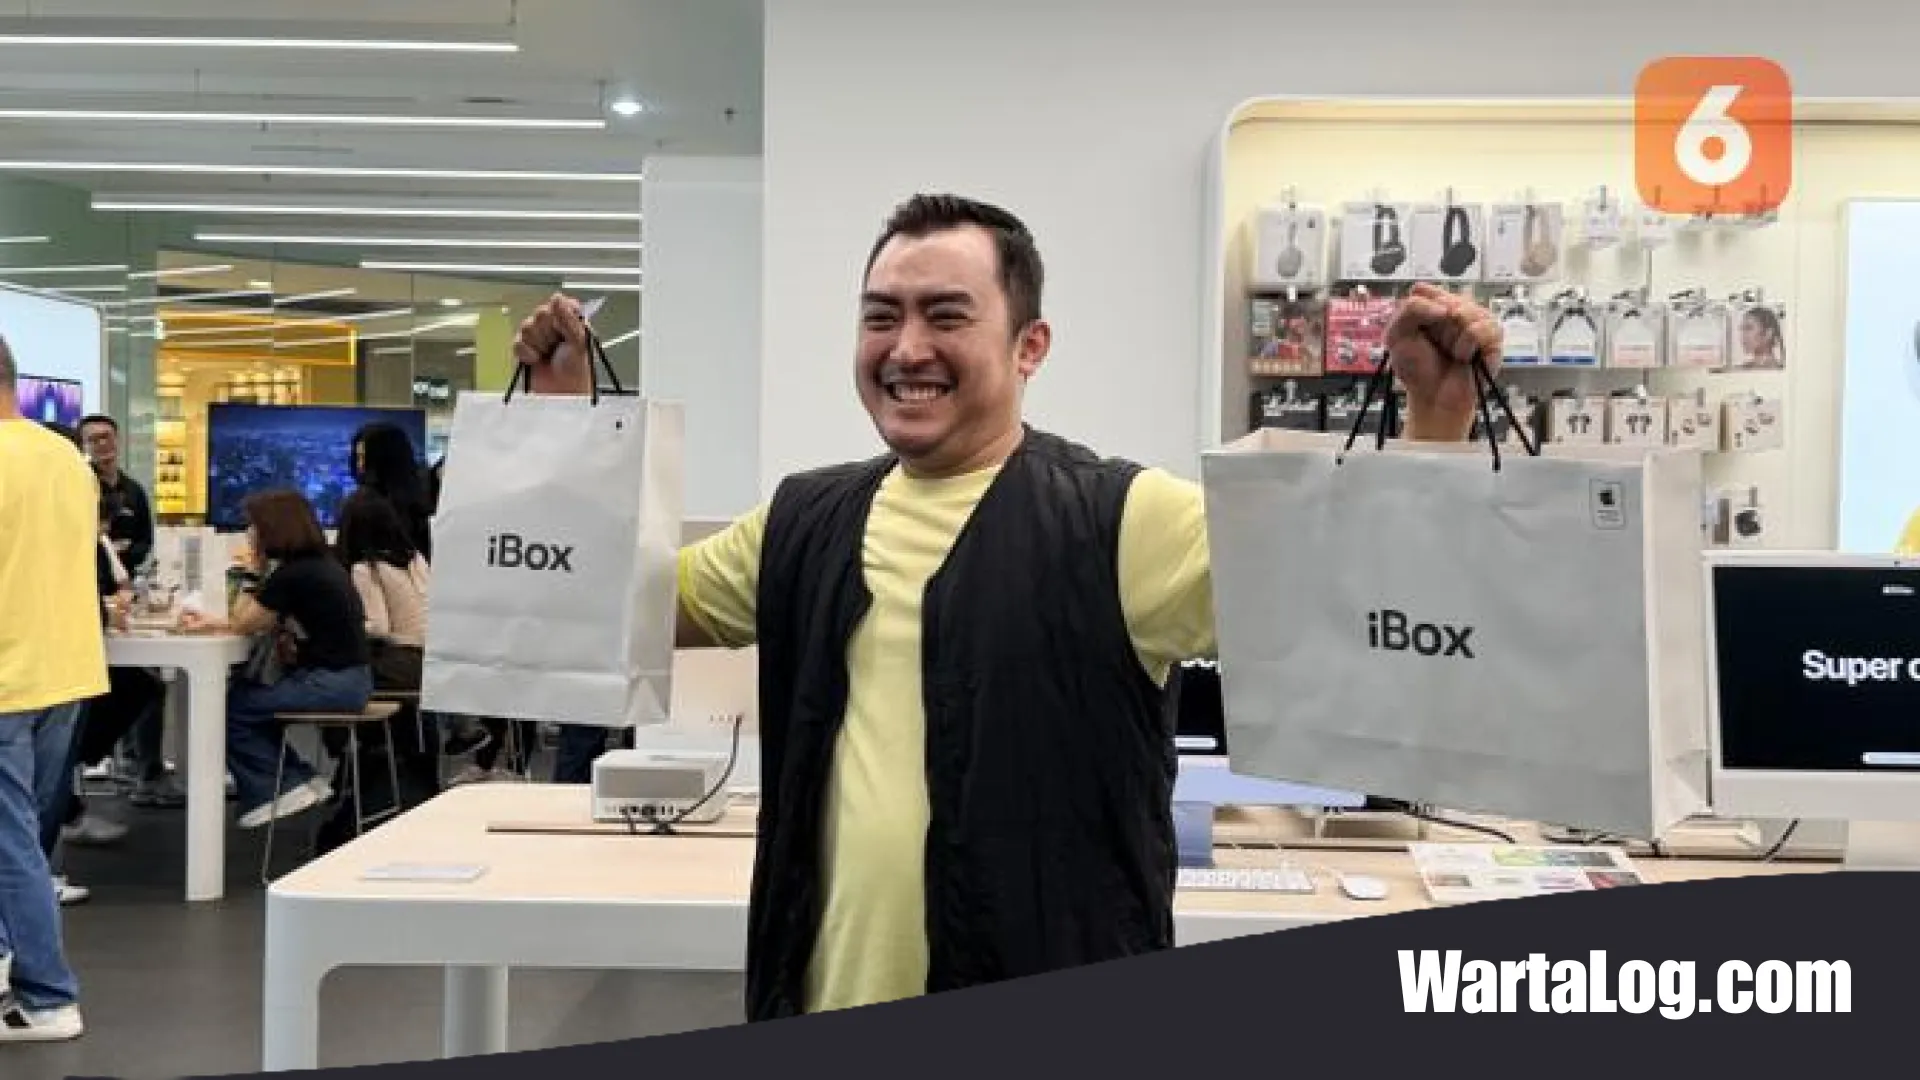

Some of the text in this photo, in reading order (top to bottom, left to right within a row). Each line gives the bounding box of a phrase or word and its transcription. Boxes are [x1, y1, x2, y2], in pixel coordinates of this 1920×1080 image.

[487, 533, 573, 573] iBox
[1368, 609, 1476, 659] iBox
[1802, 649, 1903, 686] Super
